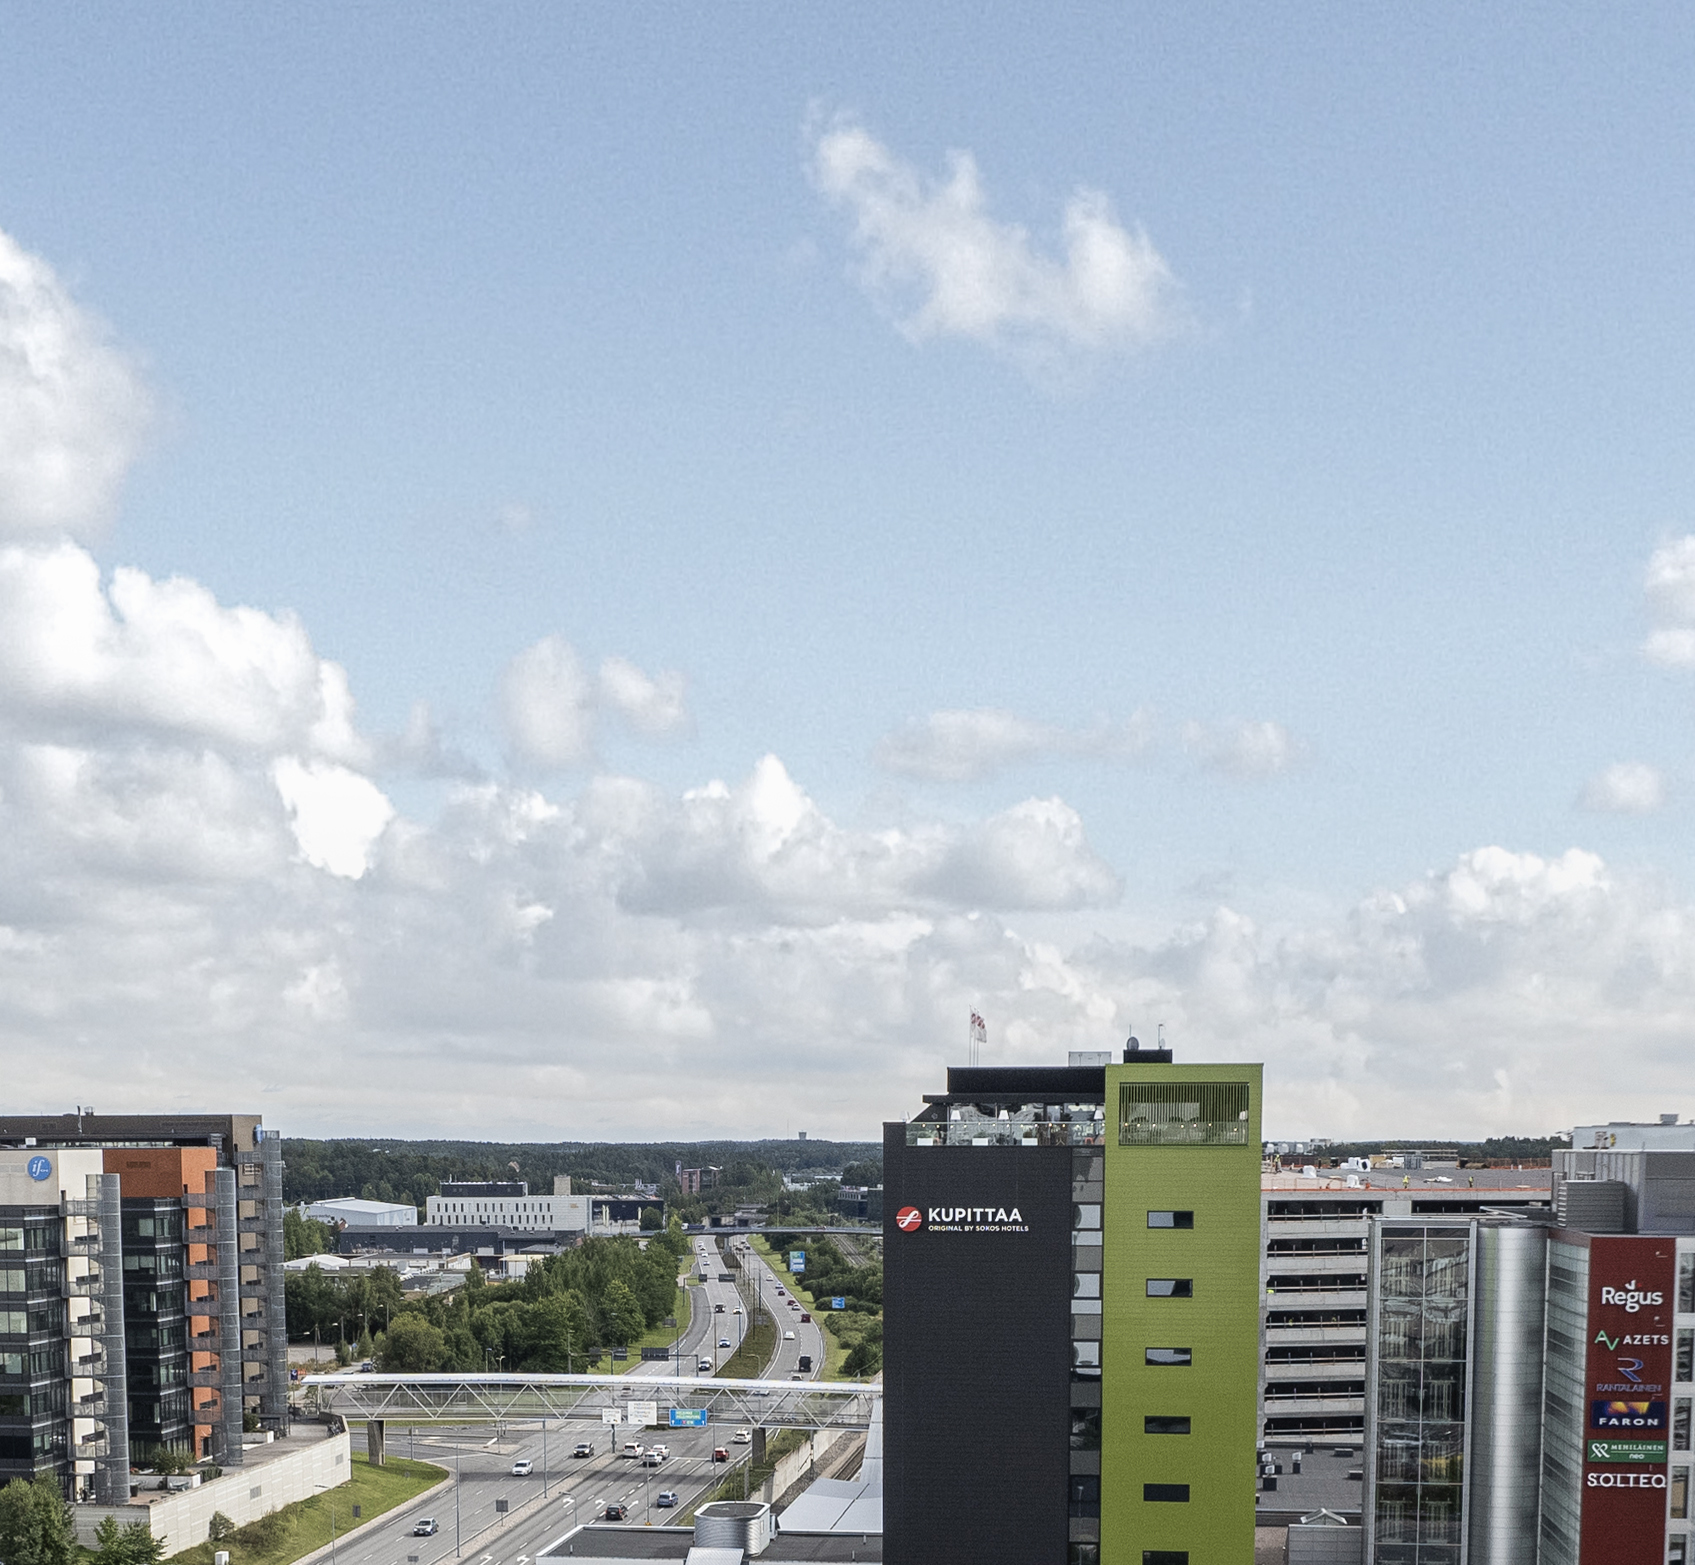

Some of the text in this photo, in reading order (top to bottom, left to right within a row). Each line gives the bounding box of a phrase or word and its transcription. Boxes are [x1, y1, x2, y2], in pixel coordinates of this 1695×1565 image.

[928, 1207, 1023, 1222] KUPITTAA
[1601, 1280, 1663, 1313] Regus
[1622, 1335, 1669, 1345] AZETS
[1596, 1383, 1662, 1393] RANTALAINEN
[1599, 1417, 1658, 1426] FARON
[1587, 1472, 1666, 1488] SOLTEQ
